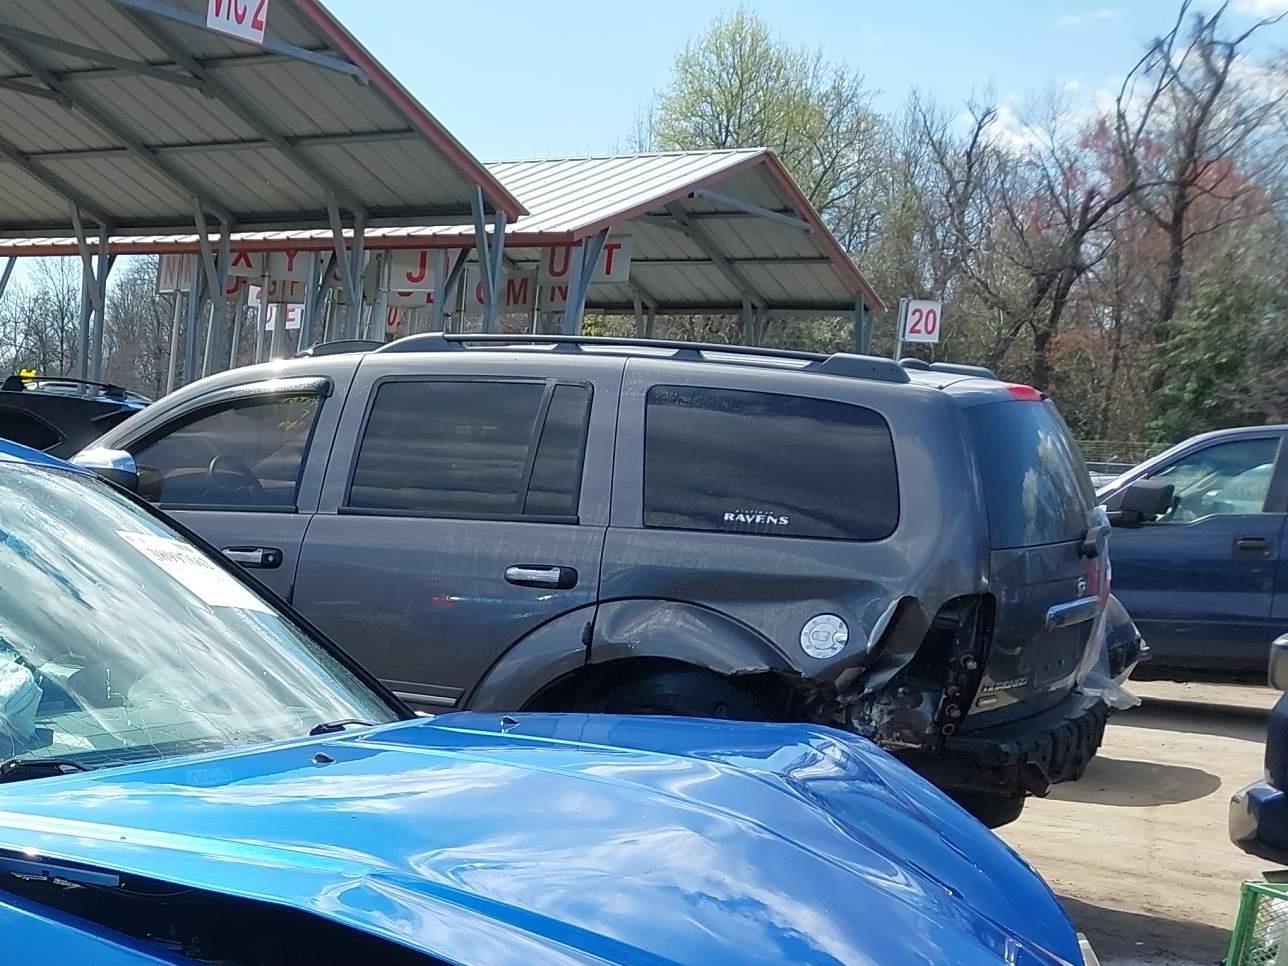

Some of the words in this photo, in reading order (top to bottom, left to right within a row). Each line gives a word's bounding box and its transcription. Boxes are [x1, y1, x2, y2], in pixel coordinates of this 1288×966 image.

[406, 251, 428, 283] J
[603, 243, 622, 276] T
[506, 277, 529, 307] M
[909, 308, 937, 335] 20
[723, 512, 790, 526] RAVENS
